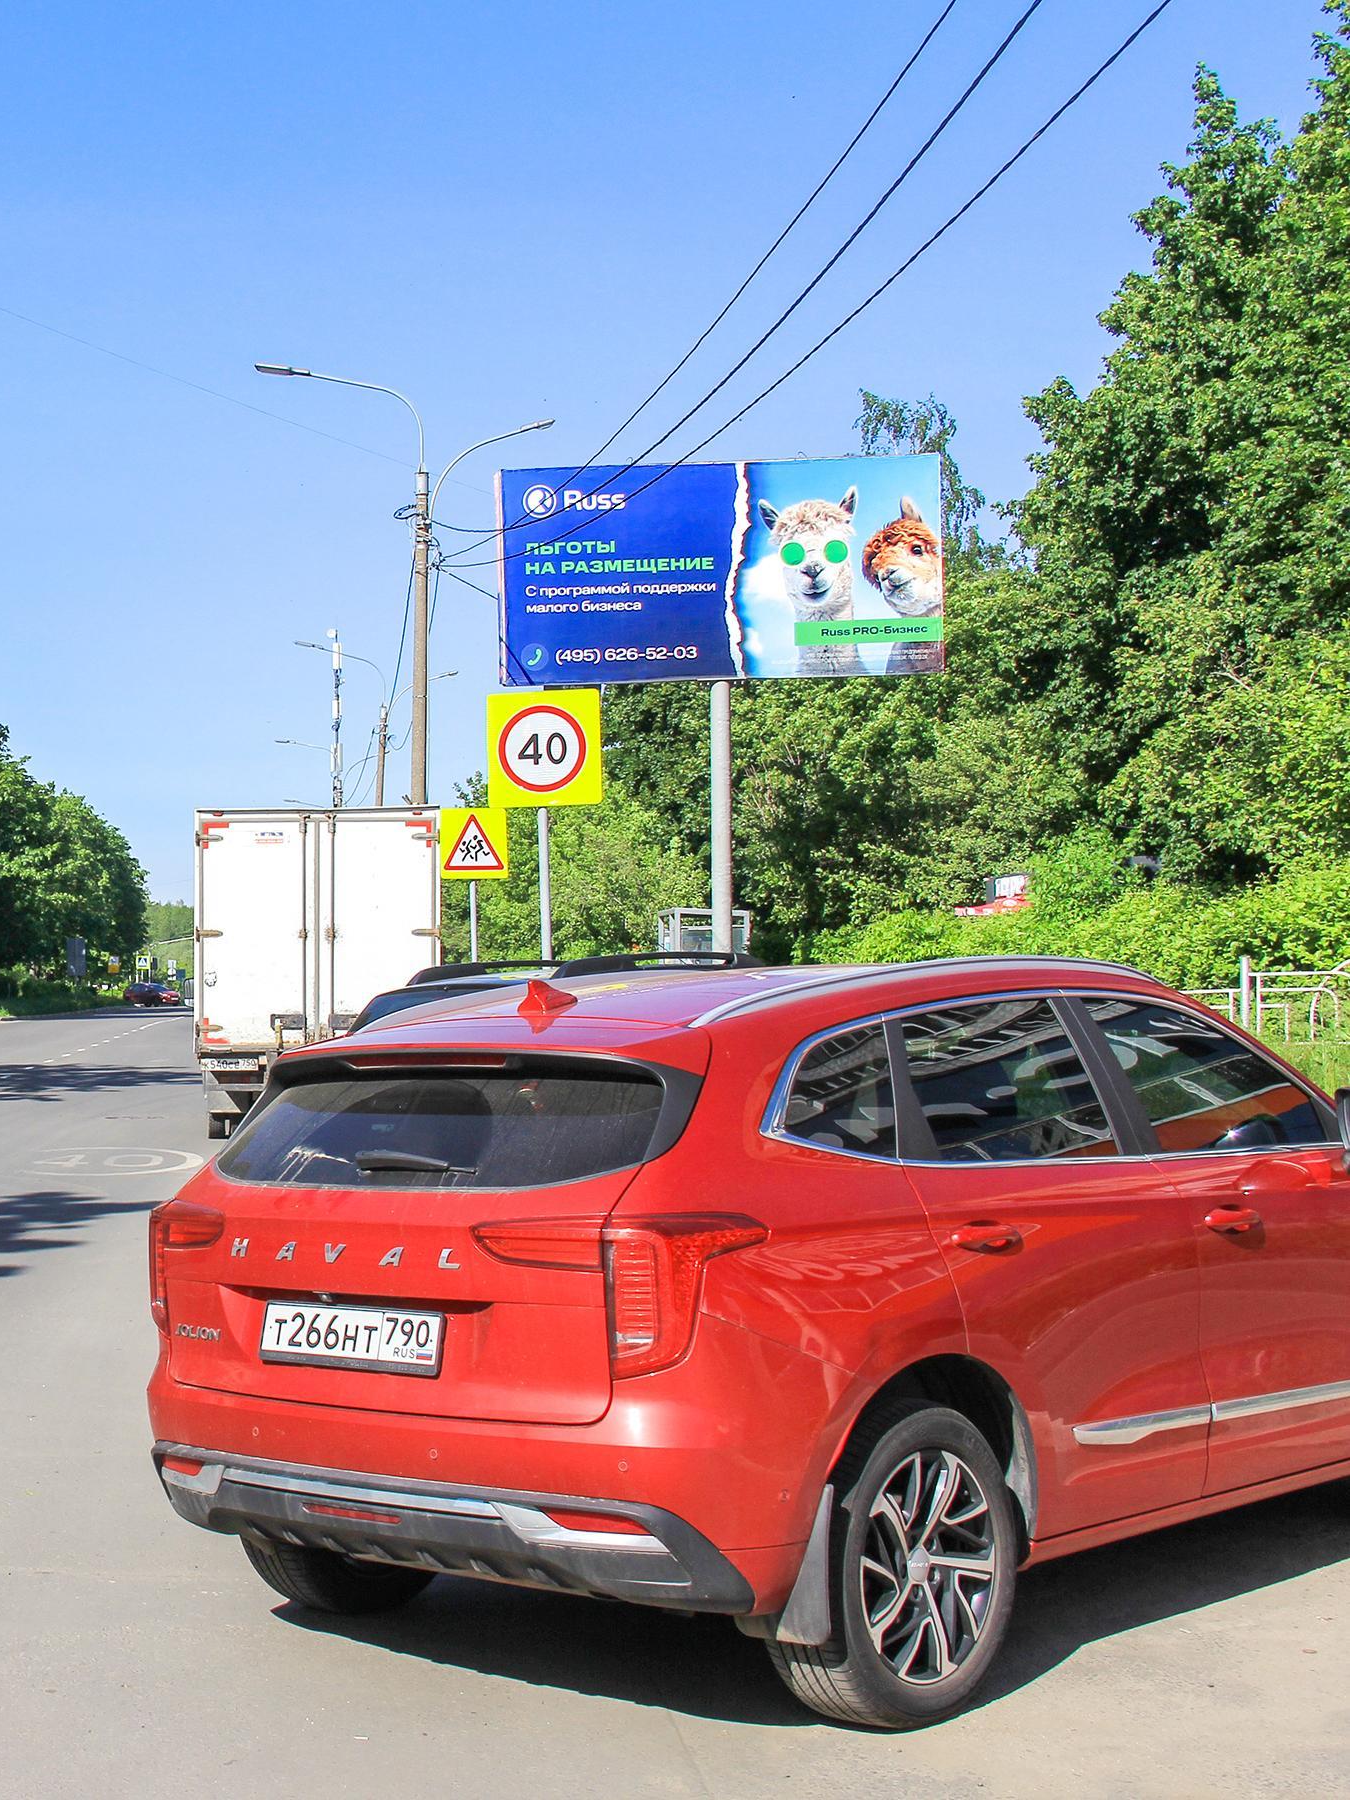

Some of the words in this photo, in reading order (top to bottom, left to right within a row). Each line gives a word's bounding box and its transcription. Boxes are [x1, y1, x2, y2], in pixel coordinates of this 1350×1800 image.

[563, 489, 626, 511] Russ
[524, 540, 616, 556] ЛЬГОТЫ
[525, 561, 556, 575] НА
[561, 556, 715, 575] РАЗМЕЩЕНИЕ
[525, 585, 538, 597] С
[539, 581, 631, 599] программой
[633, 582, 717, 597] поддержки
[525, 603, 579, 614] малого
[581, 600, 643, 613] бизнеса
[821, 628, 851, 637] Russ
[852, 625, 929, 636] PRO-Бизнес
[554, 648, 602, 666] (495)
[604, 646, 698, 662] 626-52-03
[517, 732, 568, 766] 40
[33, 1153, 164, 1168] 40
[230, 1237, 461, 1269] HAVAL
[174, 1322, 222, 1342] JOLION
[274, 1311, 379, 1354] Т266НТ
[385, 1317, 431, 1348] 790
[393, 1346, 416, 1359] RUS
